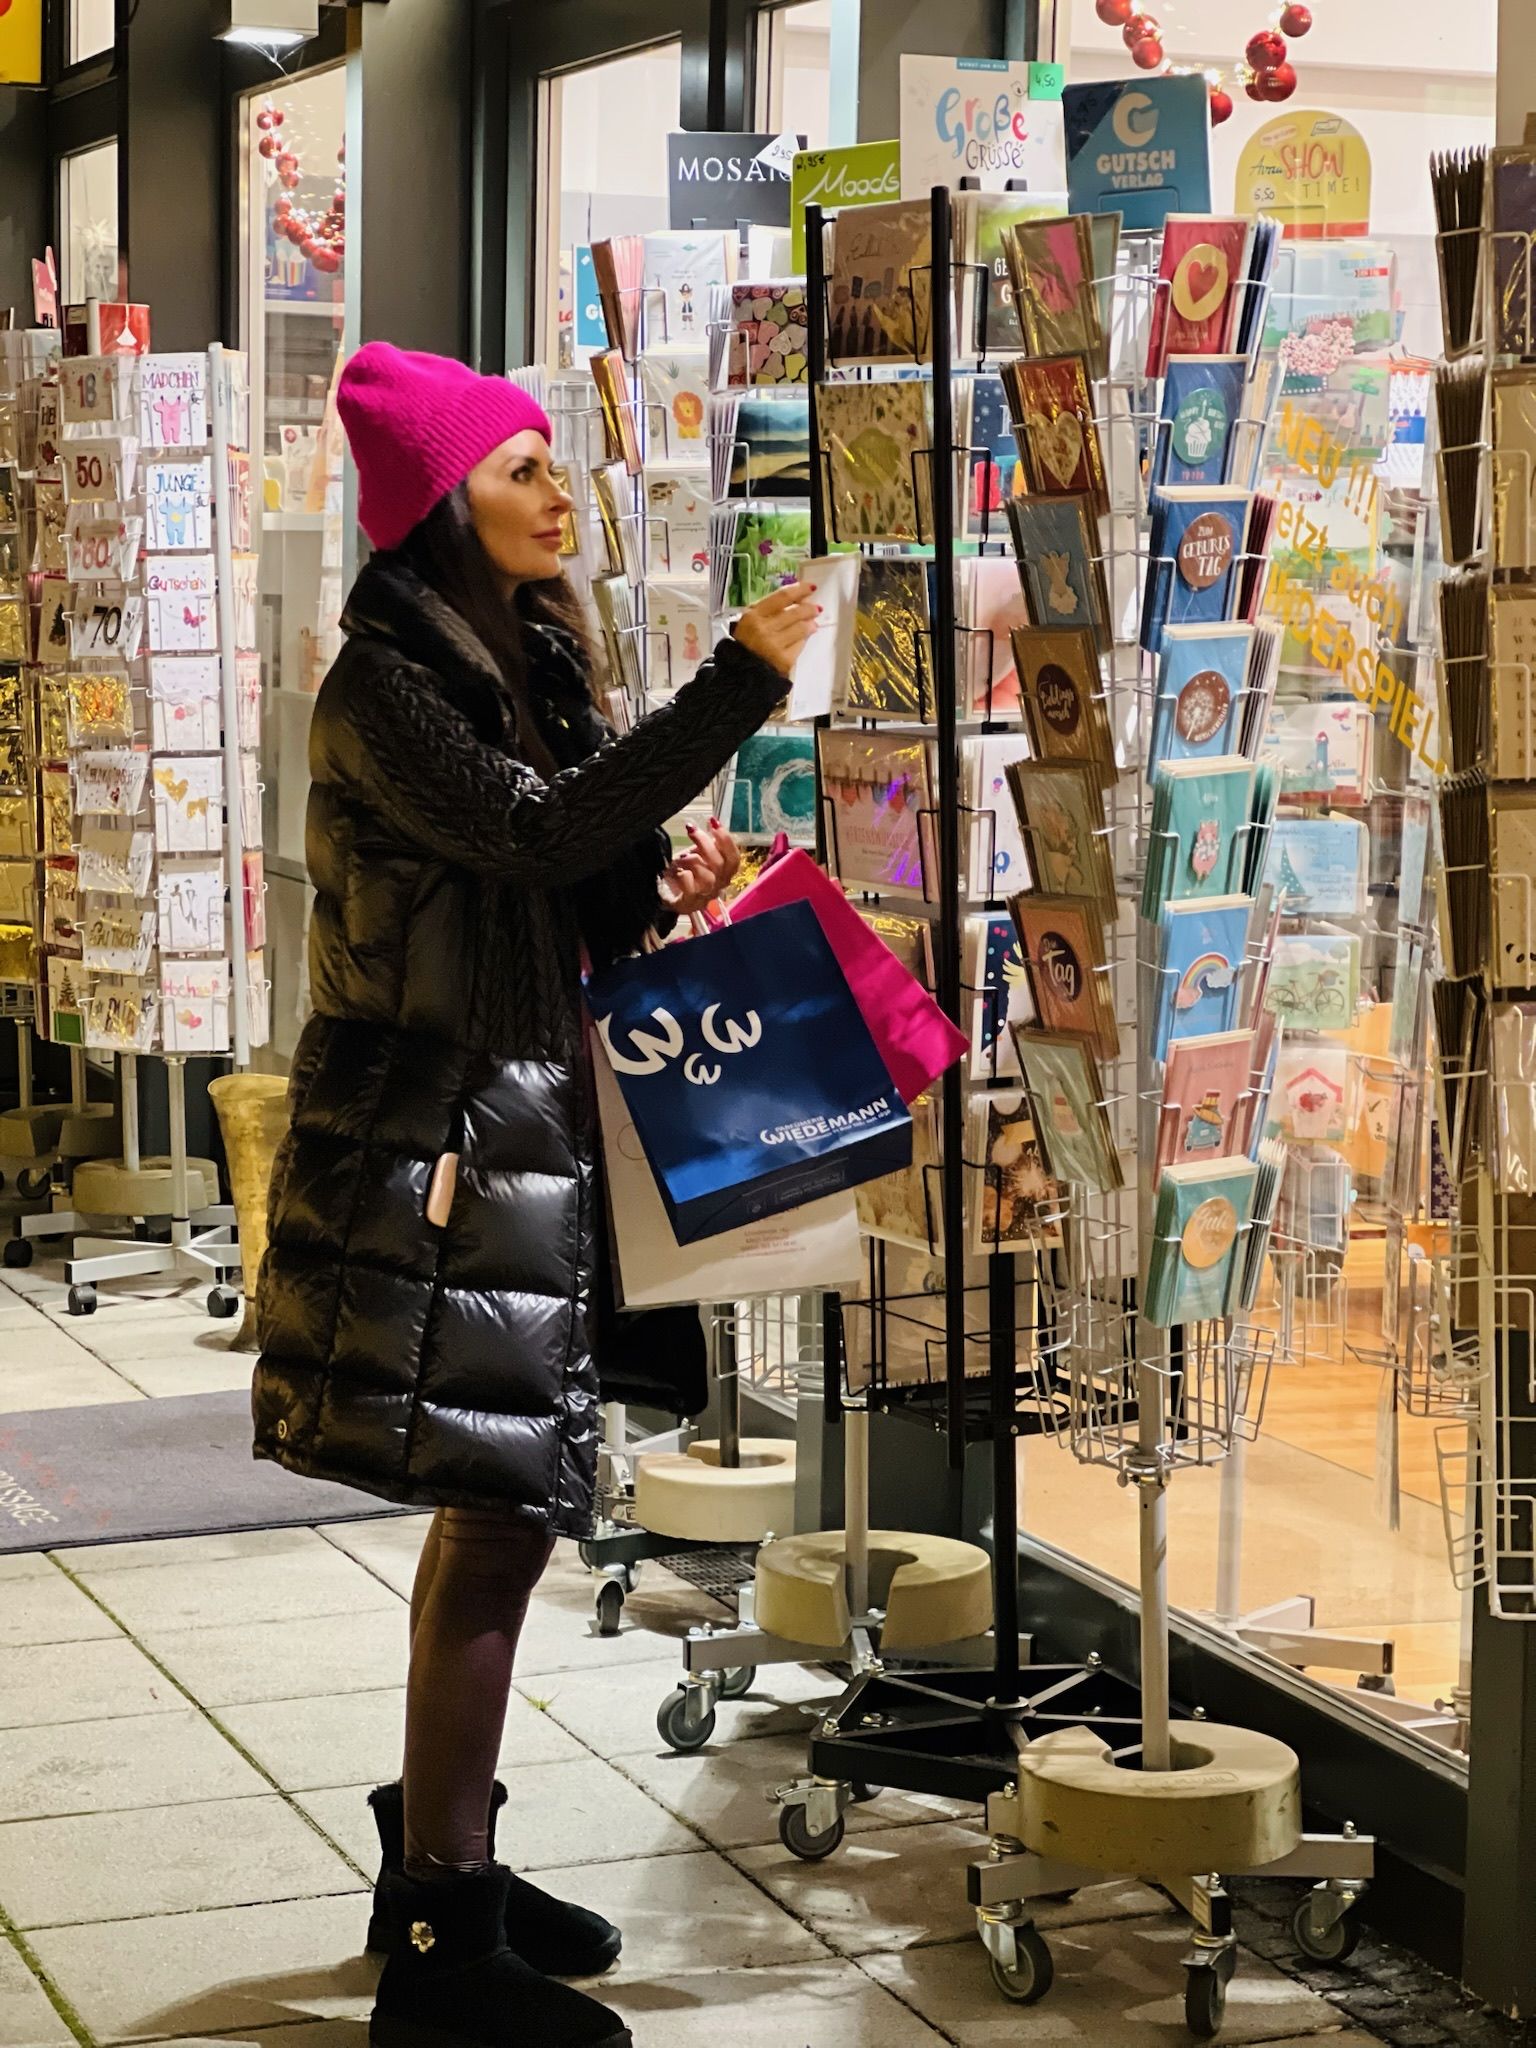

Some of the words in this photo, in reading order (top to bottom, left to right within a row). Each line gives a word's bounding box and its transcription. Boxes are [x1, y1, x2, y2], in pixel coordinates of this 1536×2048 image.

[1035, 73, 1056, 88] 4,50
[935, 87, 1029, 159] Große
[1096, 150, 1176, 174] GUTSCH
[1281, 141, 1344, 180] SHOW
[798, 162, 900, 204] Moods
[1111, 172, 1164, 189] VERLAG
[78, 372, 96, 408] 18
[76, 455, 102, 488] 50
[155, 473, 197, 494] JUNGE
[1276, 498, 1329, 573] etzt
[89, 604, 122, 649] 70
[1042, 950, 1075, 996] Tag
[760, 1097, 889, 1146] WIEDEMANN
